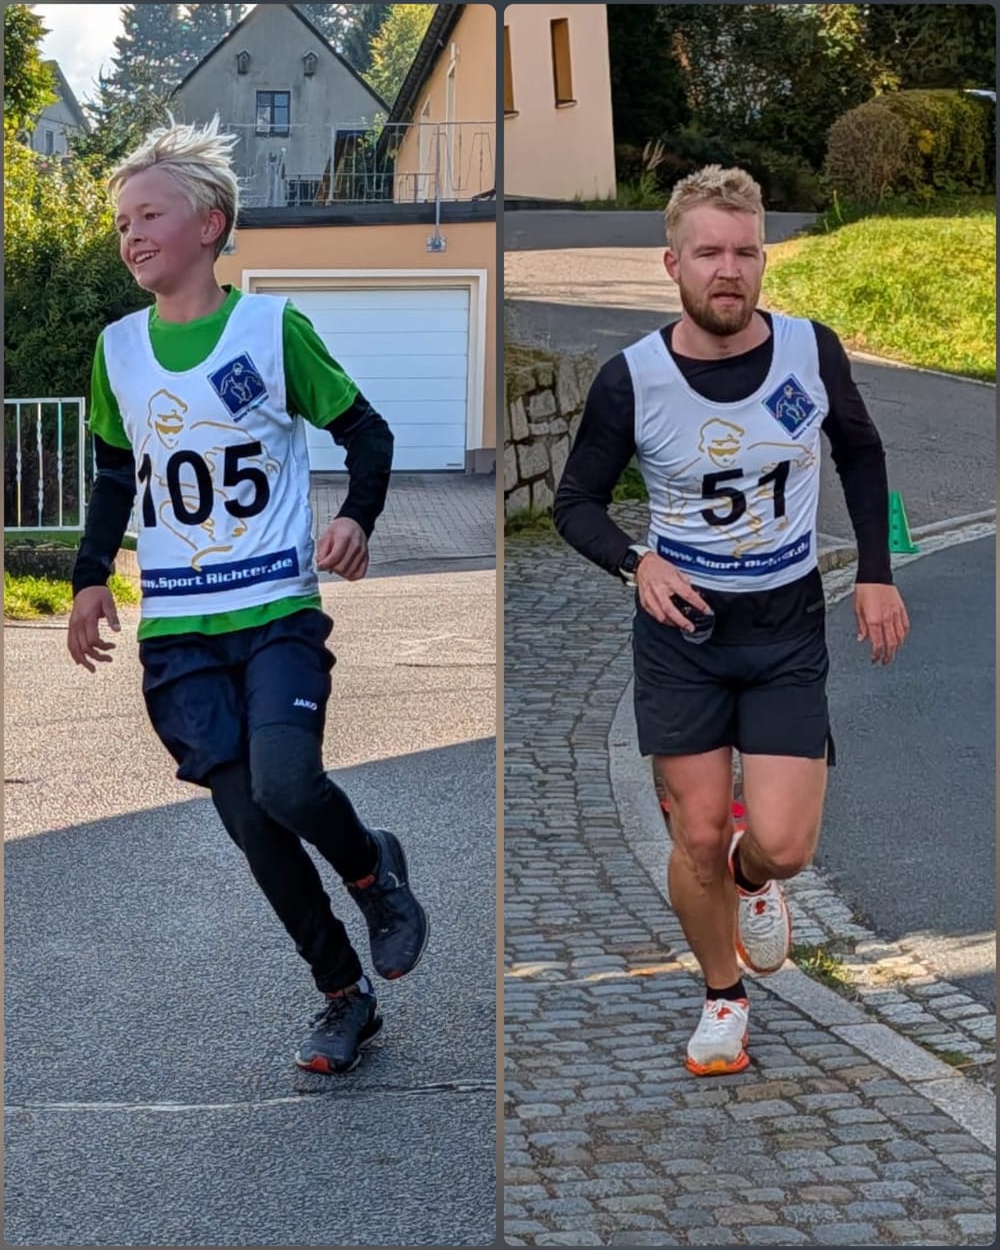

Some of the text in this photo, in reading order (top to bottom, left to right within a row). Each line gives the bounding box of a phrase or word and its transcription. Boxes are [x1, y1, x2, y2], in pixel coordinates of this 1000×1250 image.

[137, 440, 271, 528] 105
[700, 460, 791, 526] 51
[206, 557, 293, 584] Richter.de
[293, 697, 318, 711] JAKO
